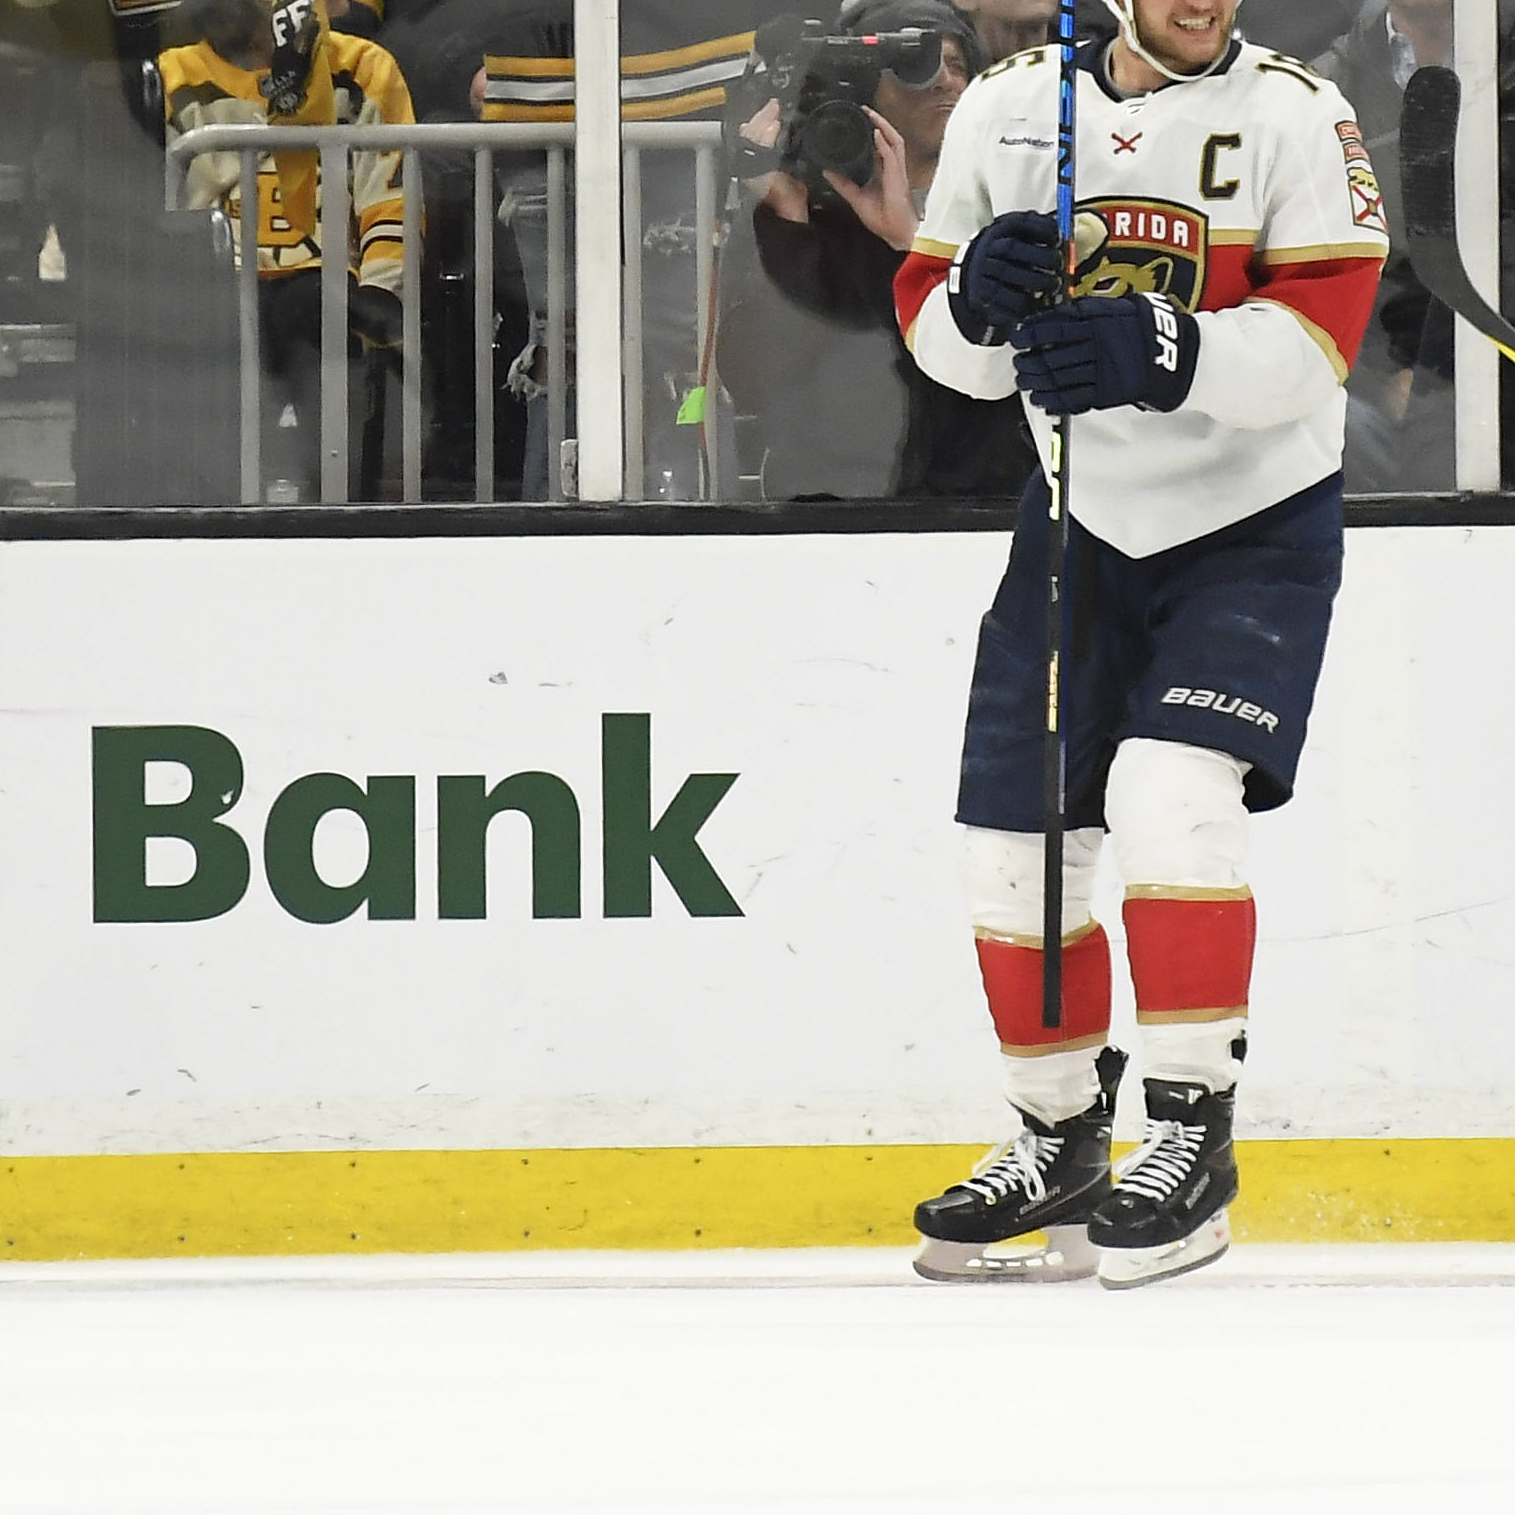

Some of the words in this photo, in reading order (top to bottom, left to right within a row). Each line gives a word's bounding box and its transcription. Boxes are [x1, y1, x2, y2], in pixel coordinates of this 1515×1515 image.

[1199, 133, 1242, 201] C
[1106, 209, 1189, 247] RIDA
[1148, 292, 1177, 373] UER
[1160, 686, 1281, 735] BAUER
[91, 713, 745, 923] Bank
